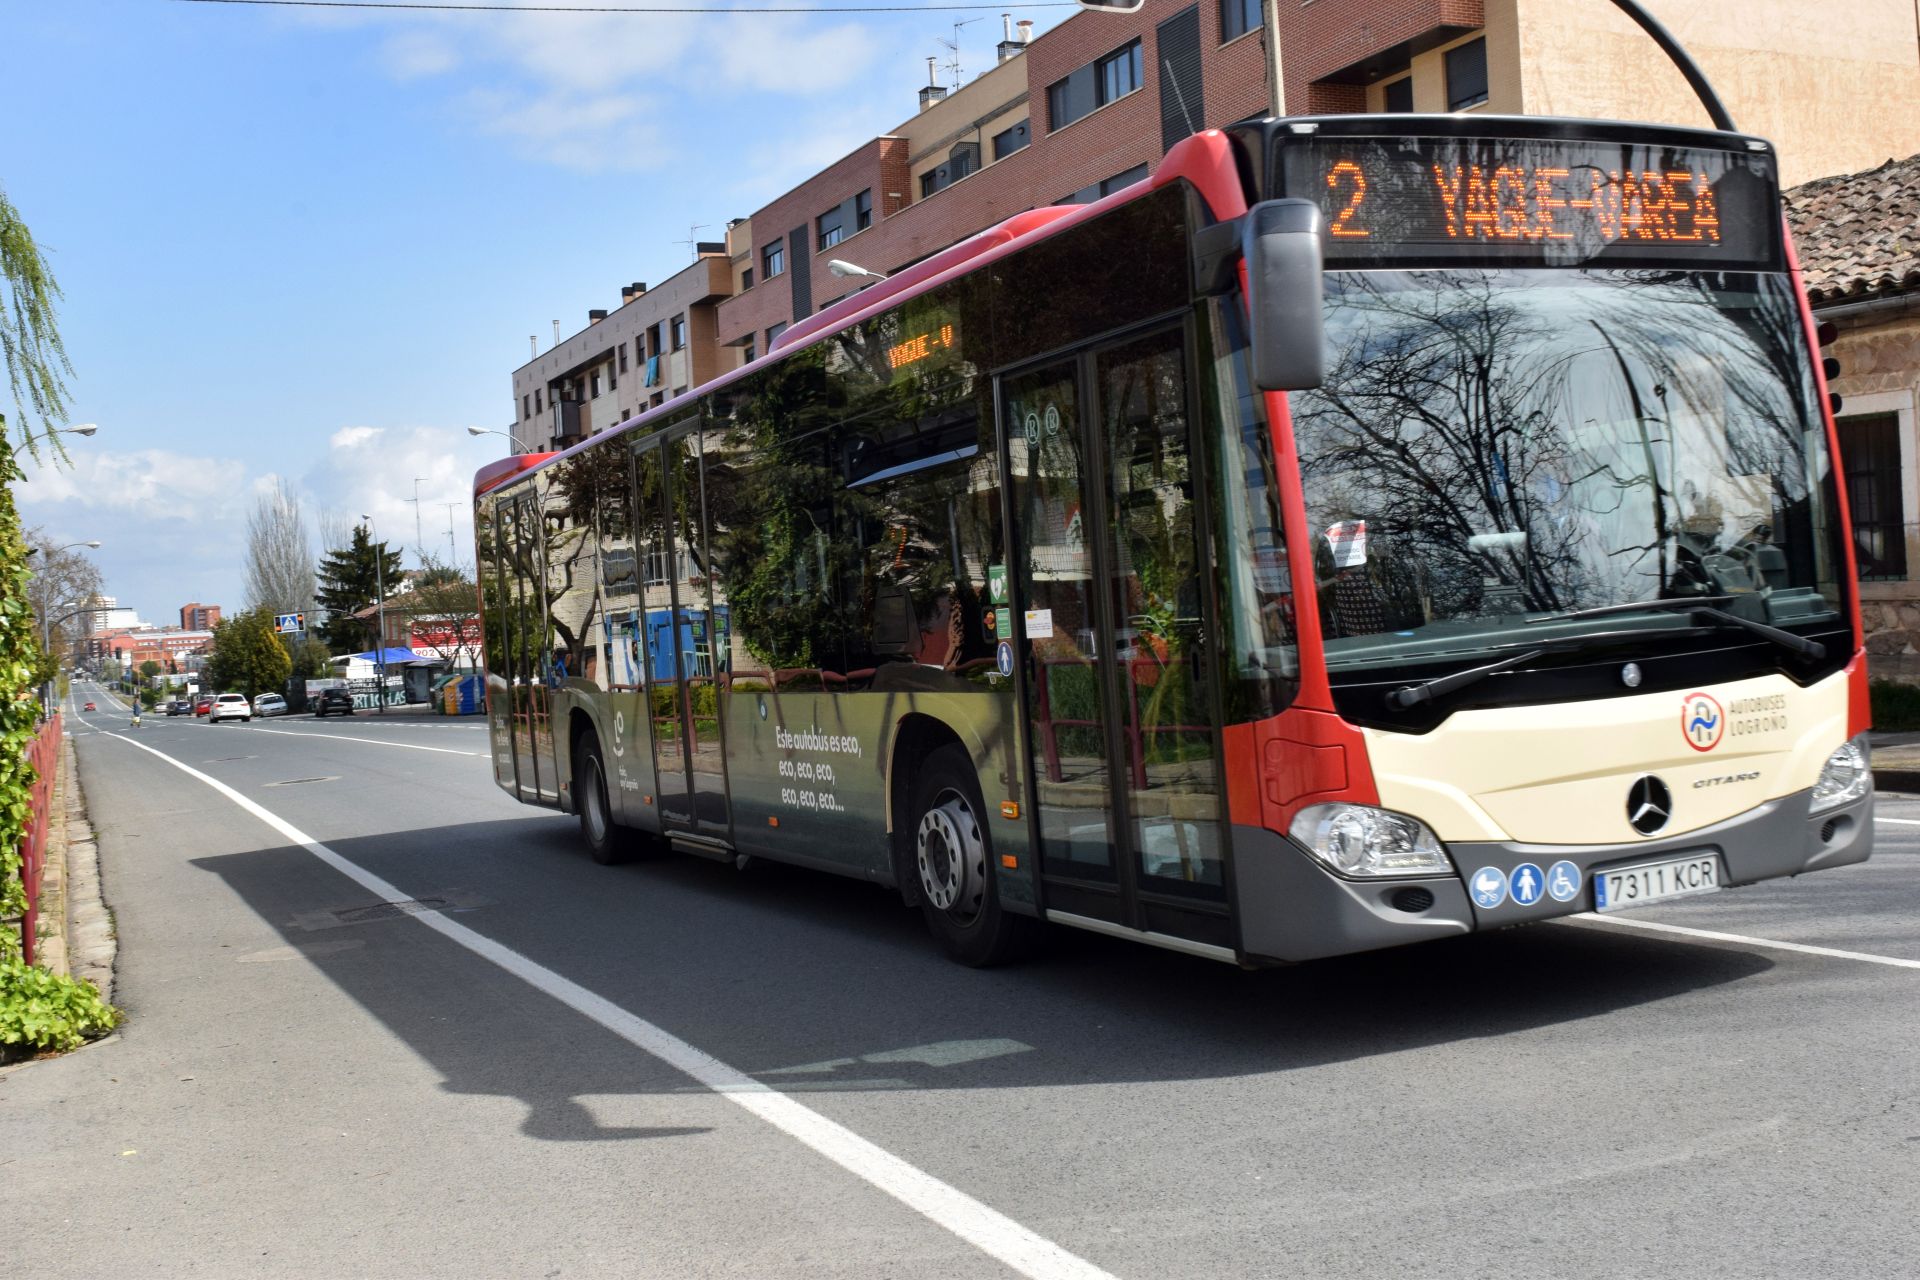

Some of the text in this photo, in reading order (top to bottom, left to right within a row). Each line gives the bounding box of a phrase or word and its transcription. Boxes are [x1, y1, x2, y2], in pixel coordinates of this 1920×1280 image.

[1327, 160, 1369, 236] 2
[1729, 694, 1786, 714] AUTOBUSES
[1730, 711, 1788, 737] LOGROÑO
[775, 724, 862, 758] Este autobús es eco,
[1693, 771, 1762, 789] CITARO
[1611, 861, 1713, 902] 7311 KCR
